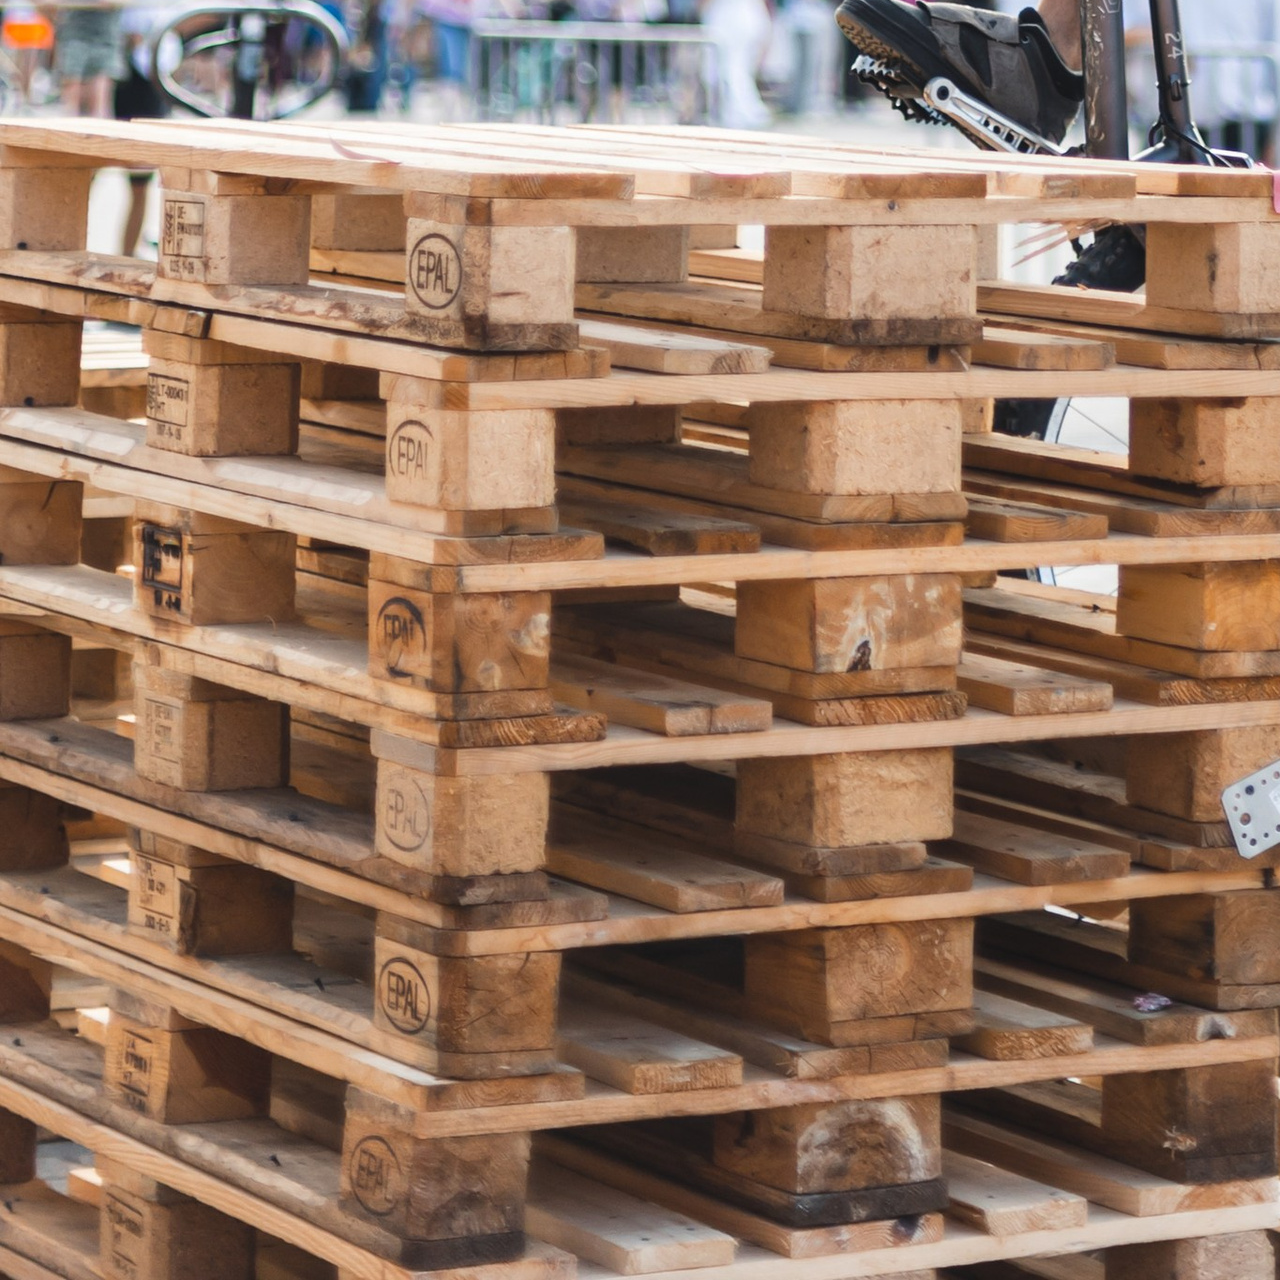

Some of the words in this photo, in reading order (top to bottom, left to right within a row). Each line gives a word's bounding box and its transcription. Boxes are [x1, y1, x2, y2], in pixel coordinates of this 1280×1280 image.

[1165, 31, 1183, 59] 24
[416, 249, 454, 294] EPAL
[387, 970, 424, 1023] EPAL
[357, 1148, 395, 1205] EPAL
